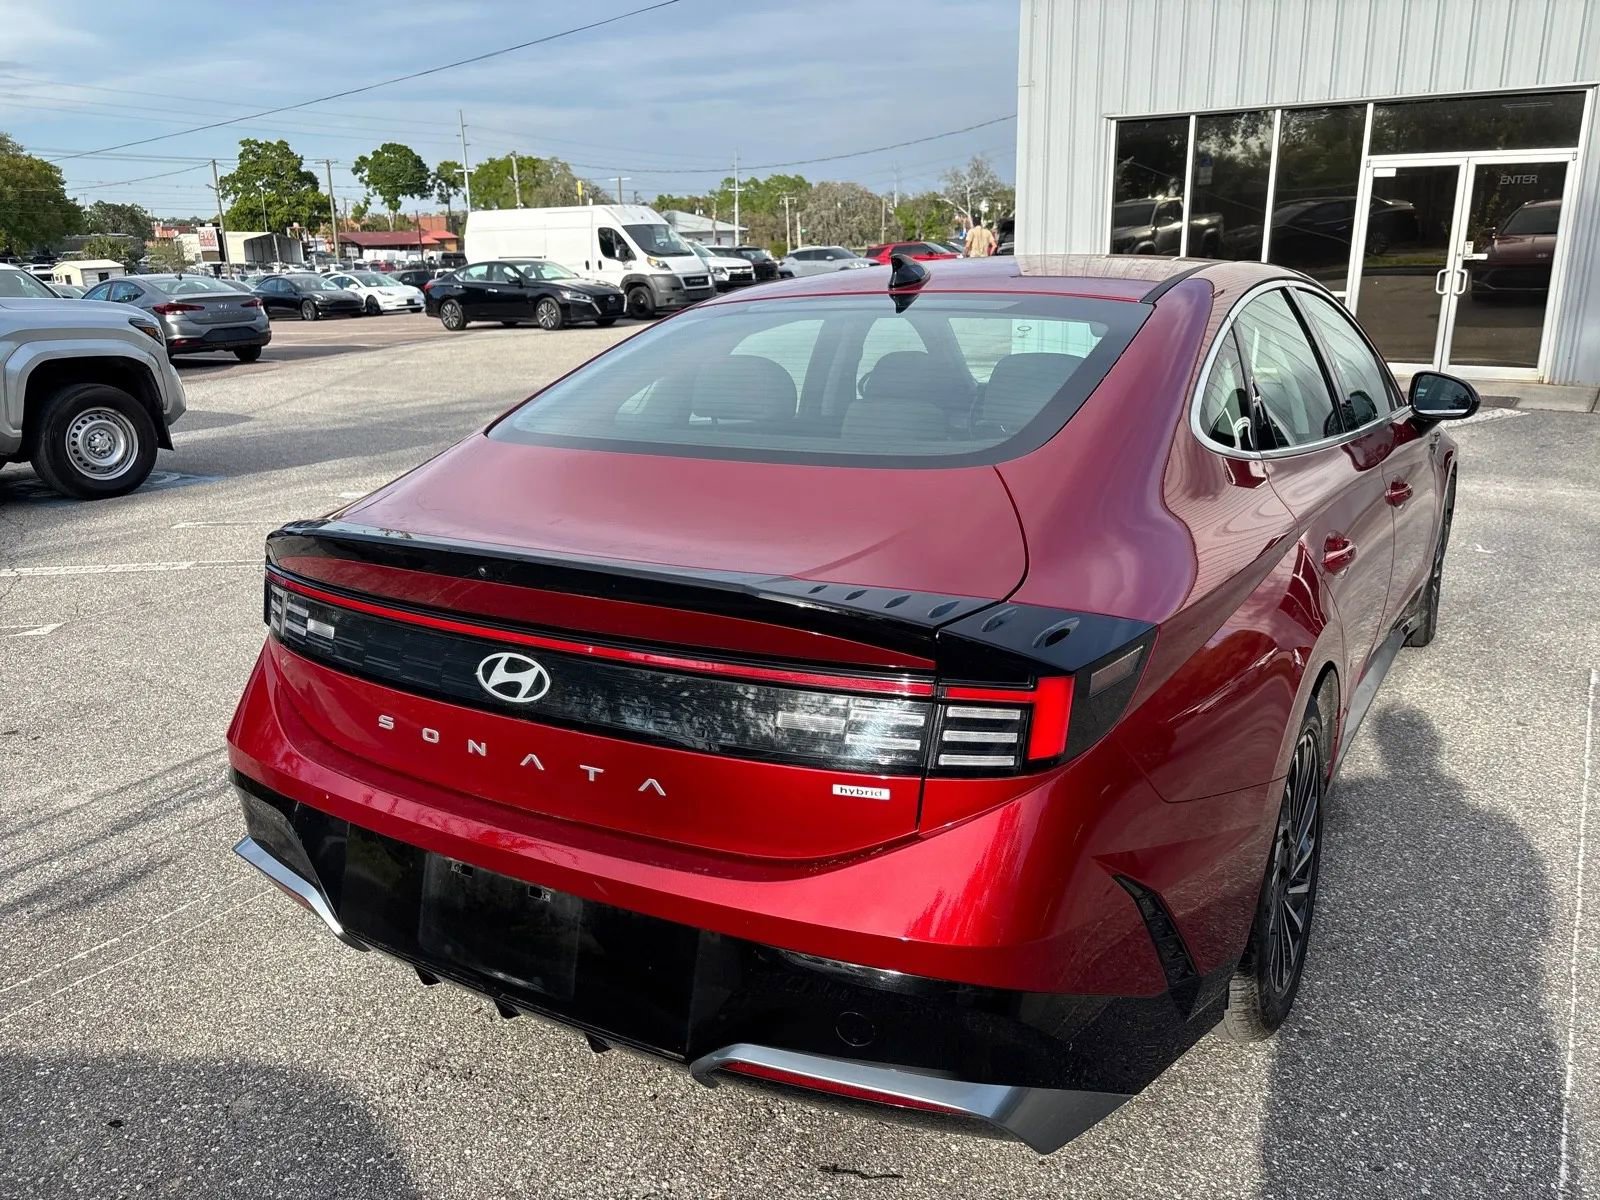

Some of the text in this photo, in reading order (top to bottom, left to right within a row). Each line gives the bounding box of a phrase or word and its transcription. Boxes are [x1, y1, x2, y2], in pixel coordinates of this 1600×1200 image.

[1500, 174, 1538, 185] ENTER
[378, 714, 667, 797] SONATA
[840, 786, 883, 797] hybrid
